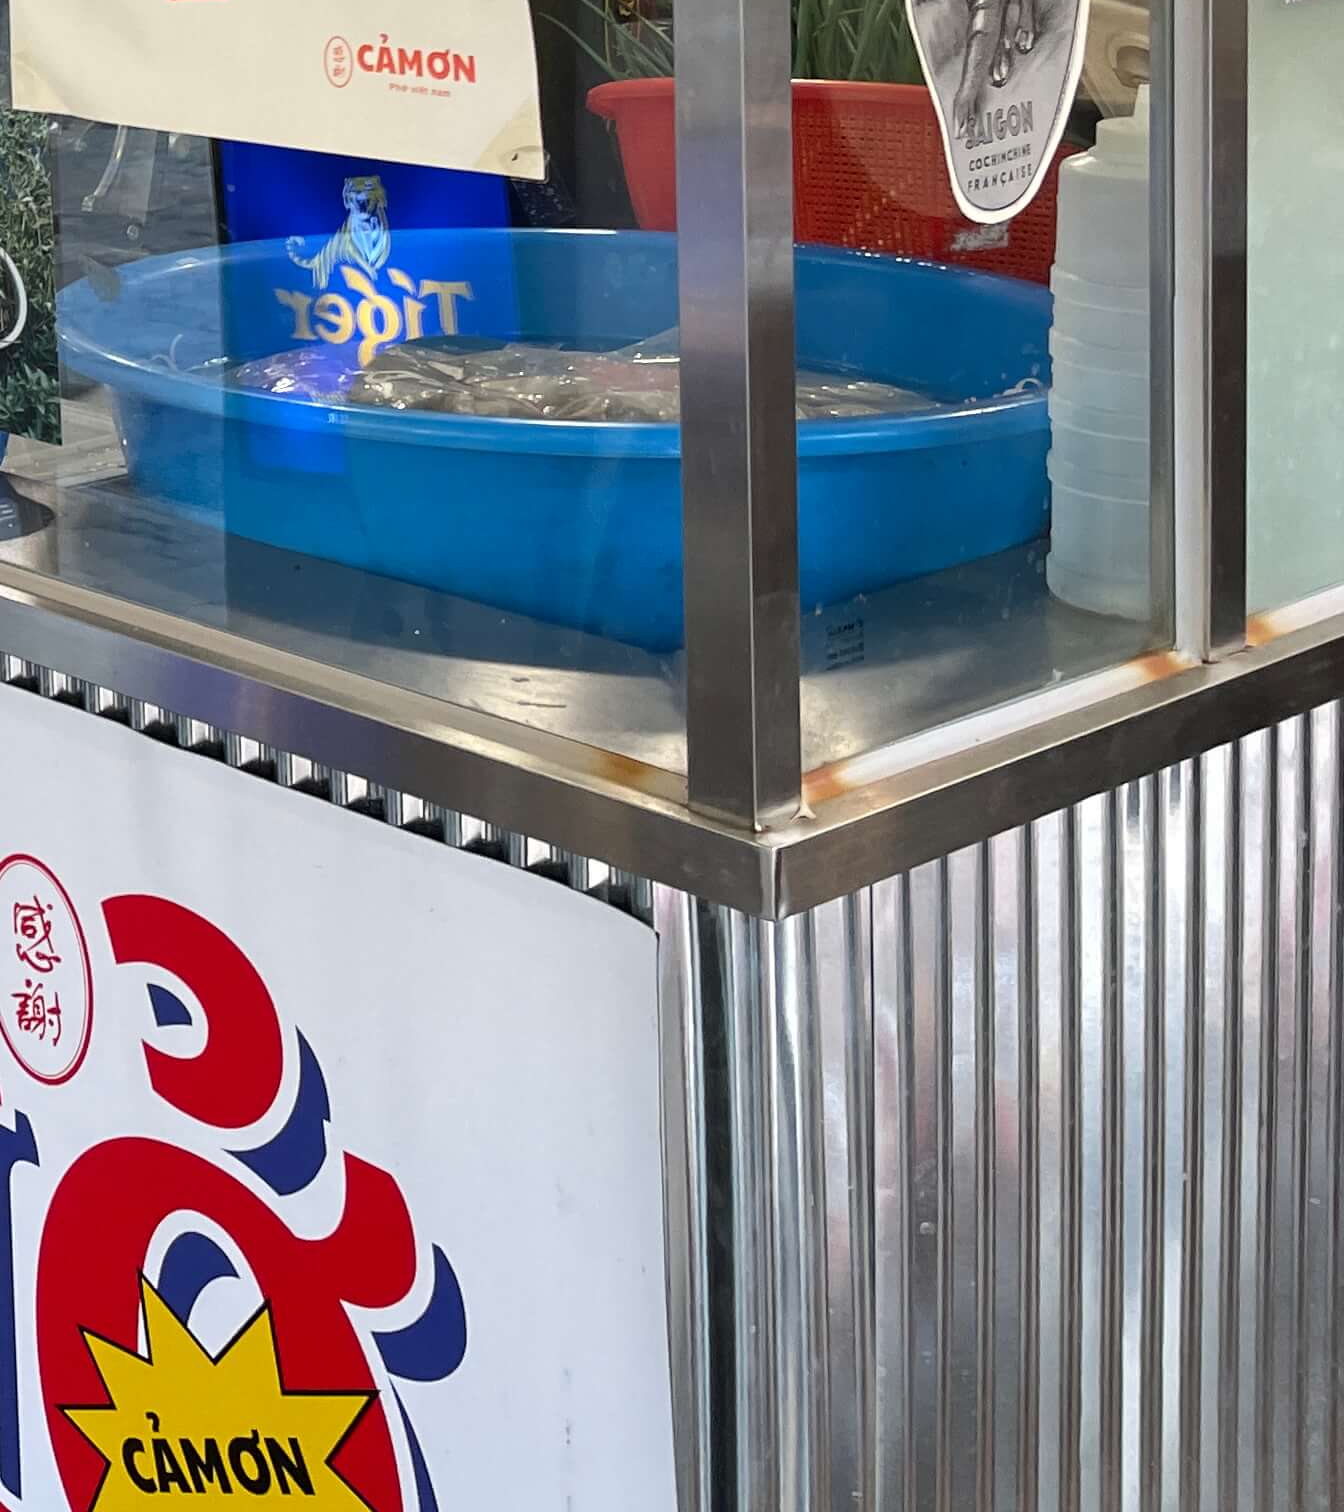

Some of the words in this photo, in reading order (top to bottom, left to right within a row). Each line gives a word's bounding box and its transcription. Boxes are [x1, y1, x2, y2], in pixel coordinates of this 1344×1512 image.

[356, 32, 477, 84] CẢMƠN
[964, 100, 1034, 151] SAIGON
[966, 163, 1033, 194] FRANÇAISE
[968, 143, 1032, 172] COCHINCHINE
[122, 1410, 311, 1498] CẢMƠN
